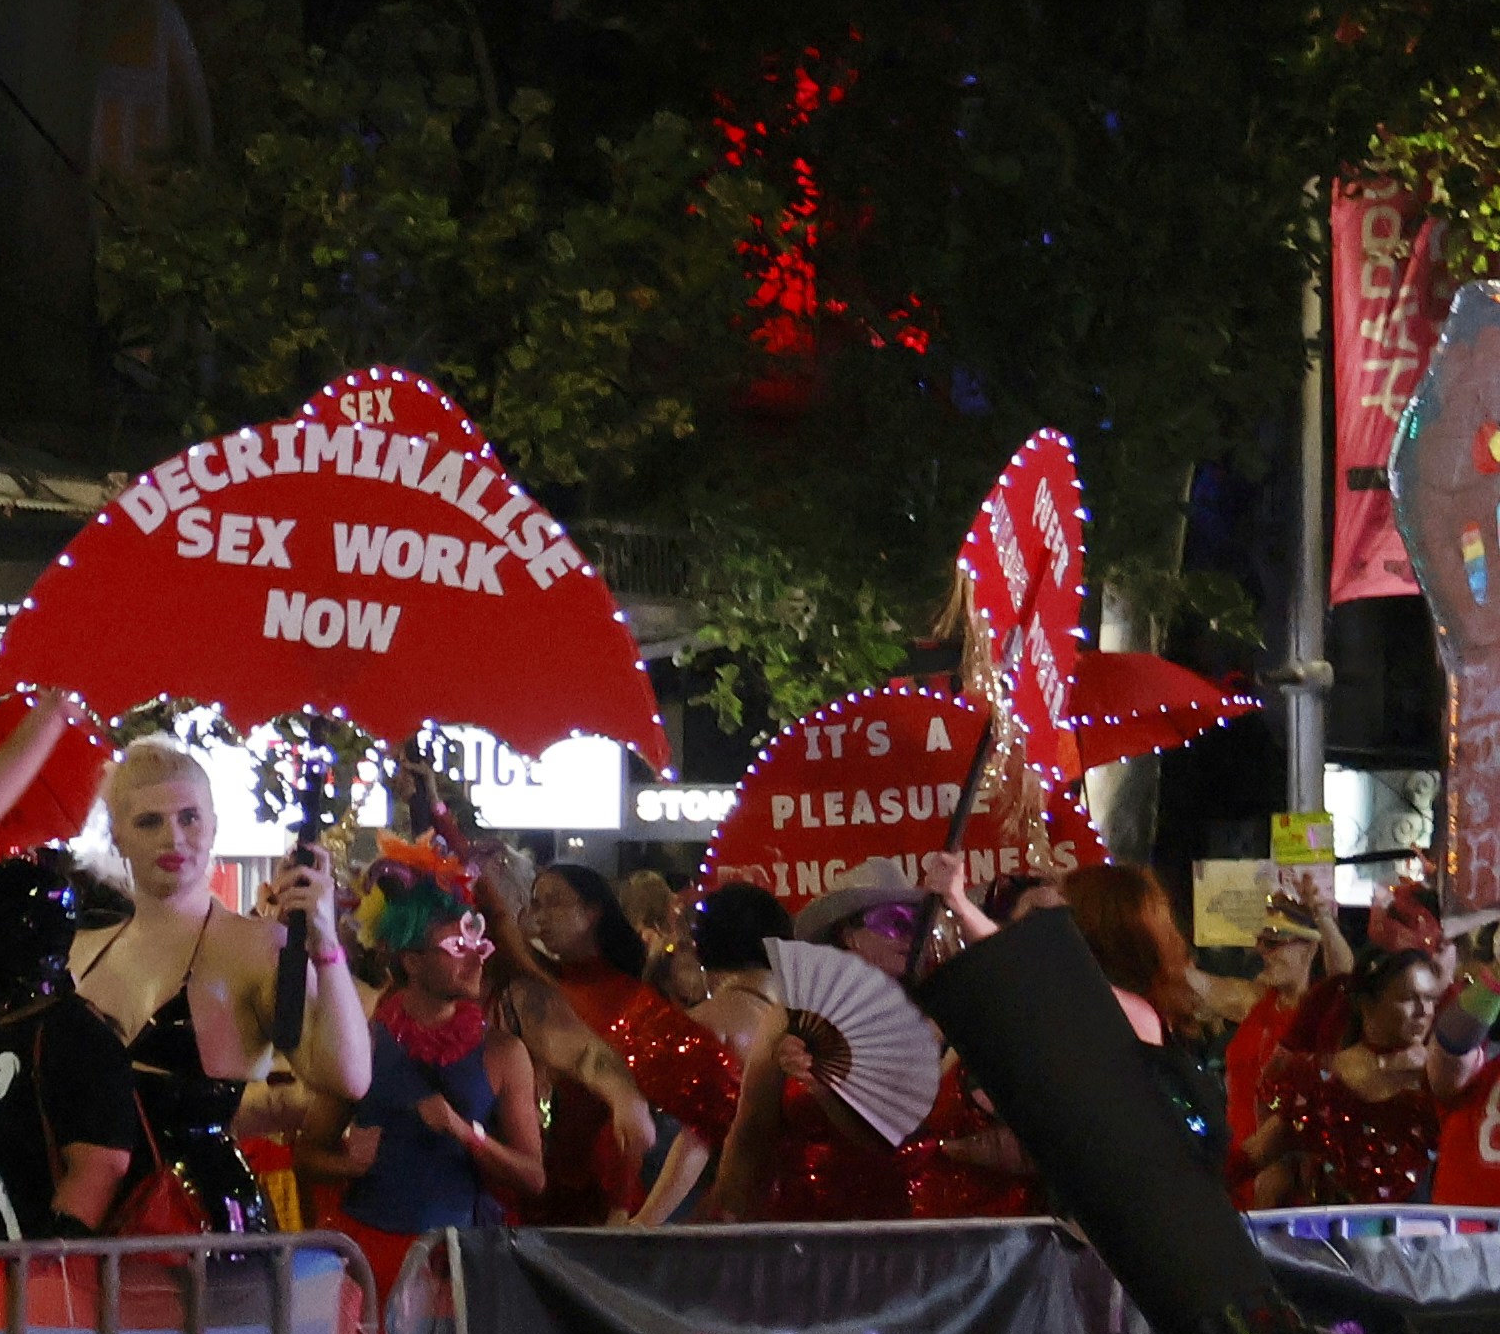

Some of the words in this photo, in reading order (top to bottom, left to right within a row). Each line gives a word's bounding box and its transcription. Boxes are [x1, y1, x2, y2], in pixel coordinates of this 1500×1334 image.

[339, 386, 396, 425] SEX
[117, 421, 583, 591] DECRIMINALISE
[176, 505, 297, 569] SEX
[332, 521, 509, 596] WORK
[262, 587, 402, 654] NOW
[803, 716, 892, 761] IT'S
[925, 715, 953, 754] A
[770, 782, 992, 831] PLEASURE
